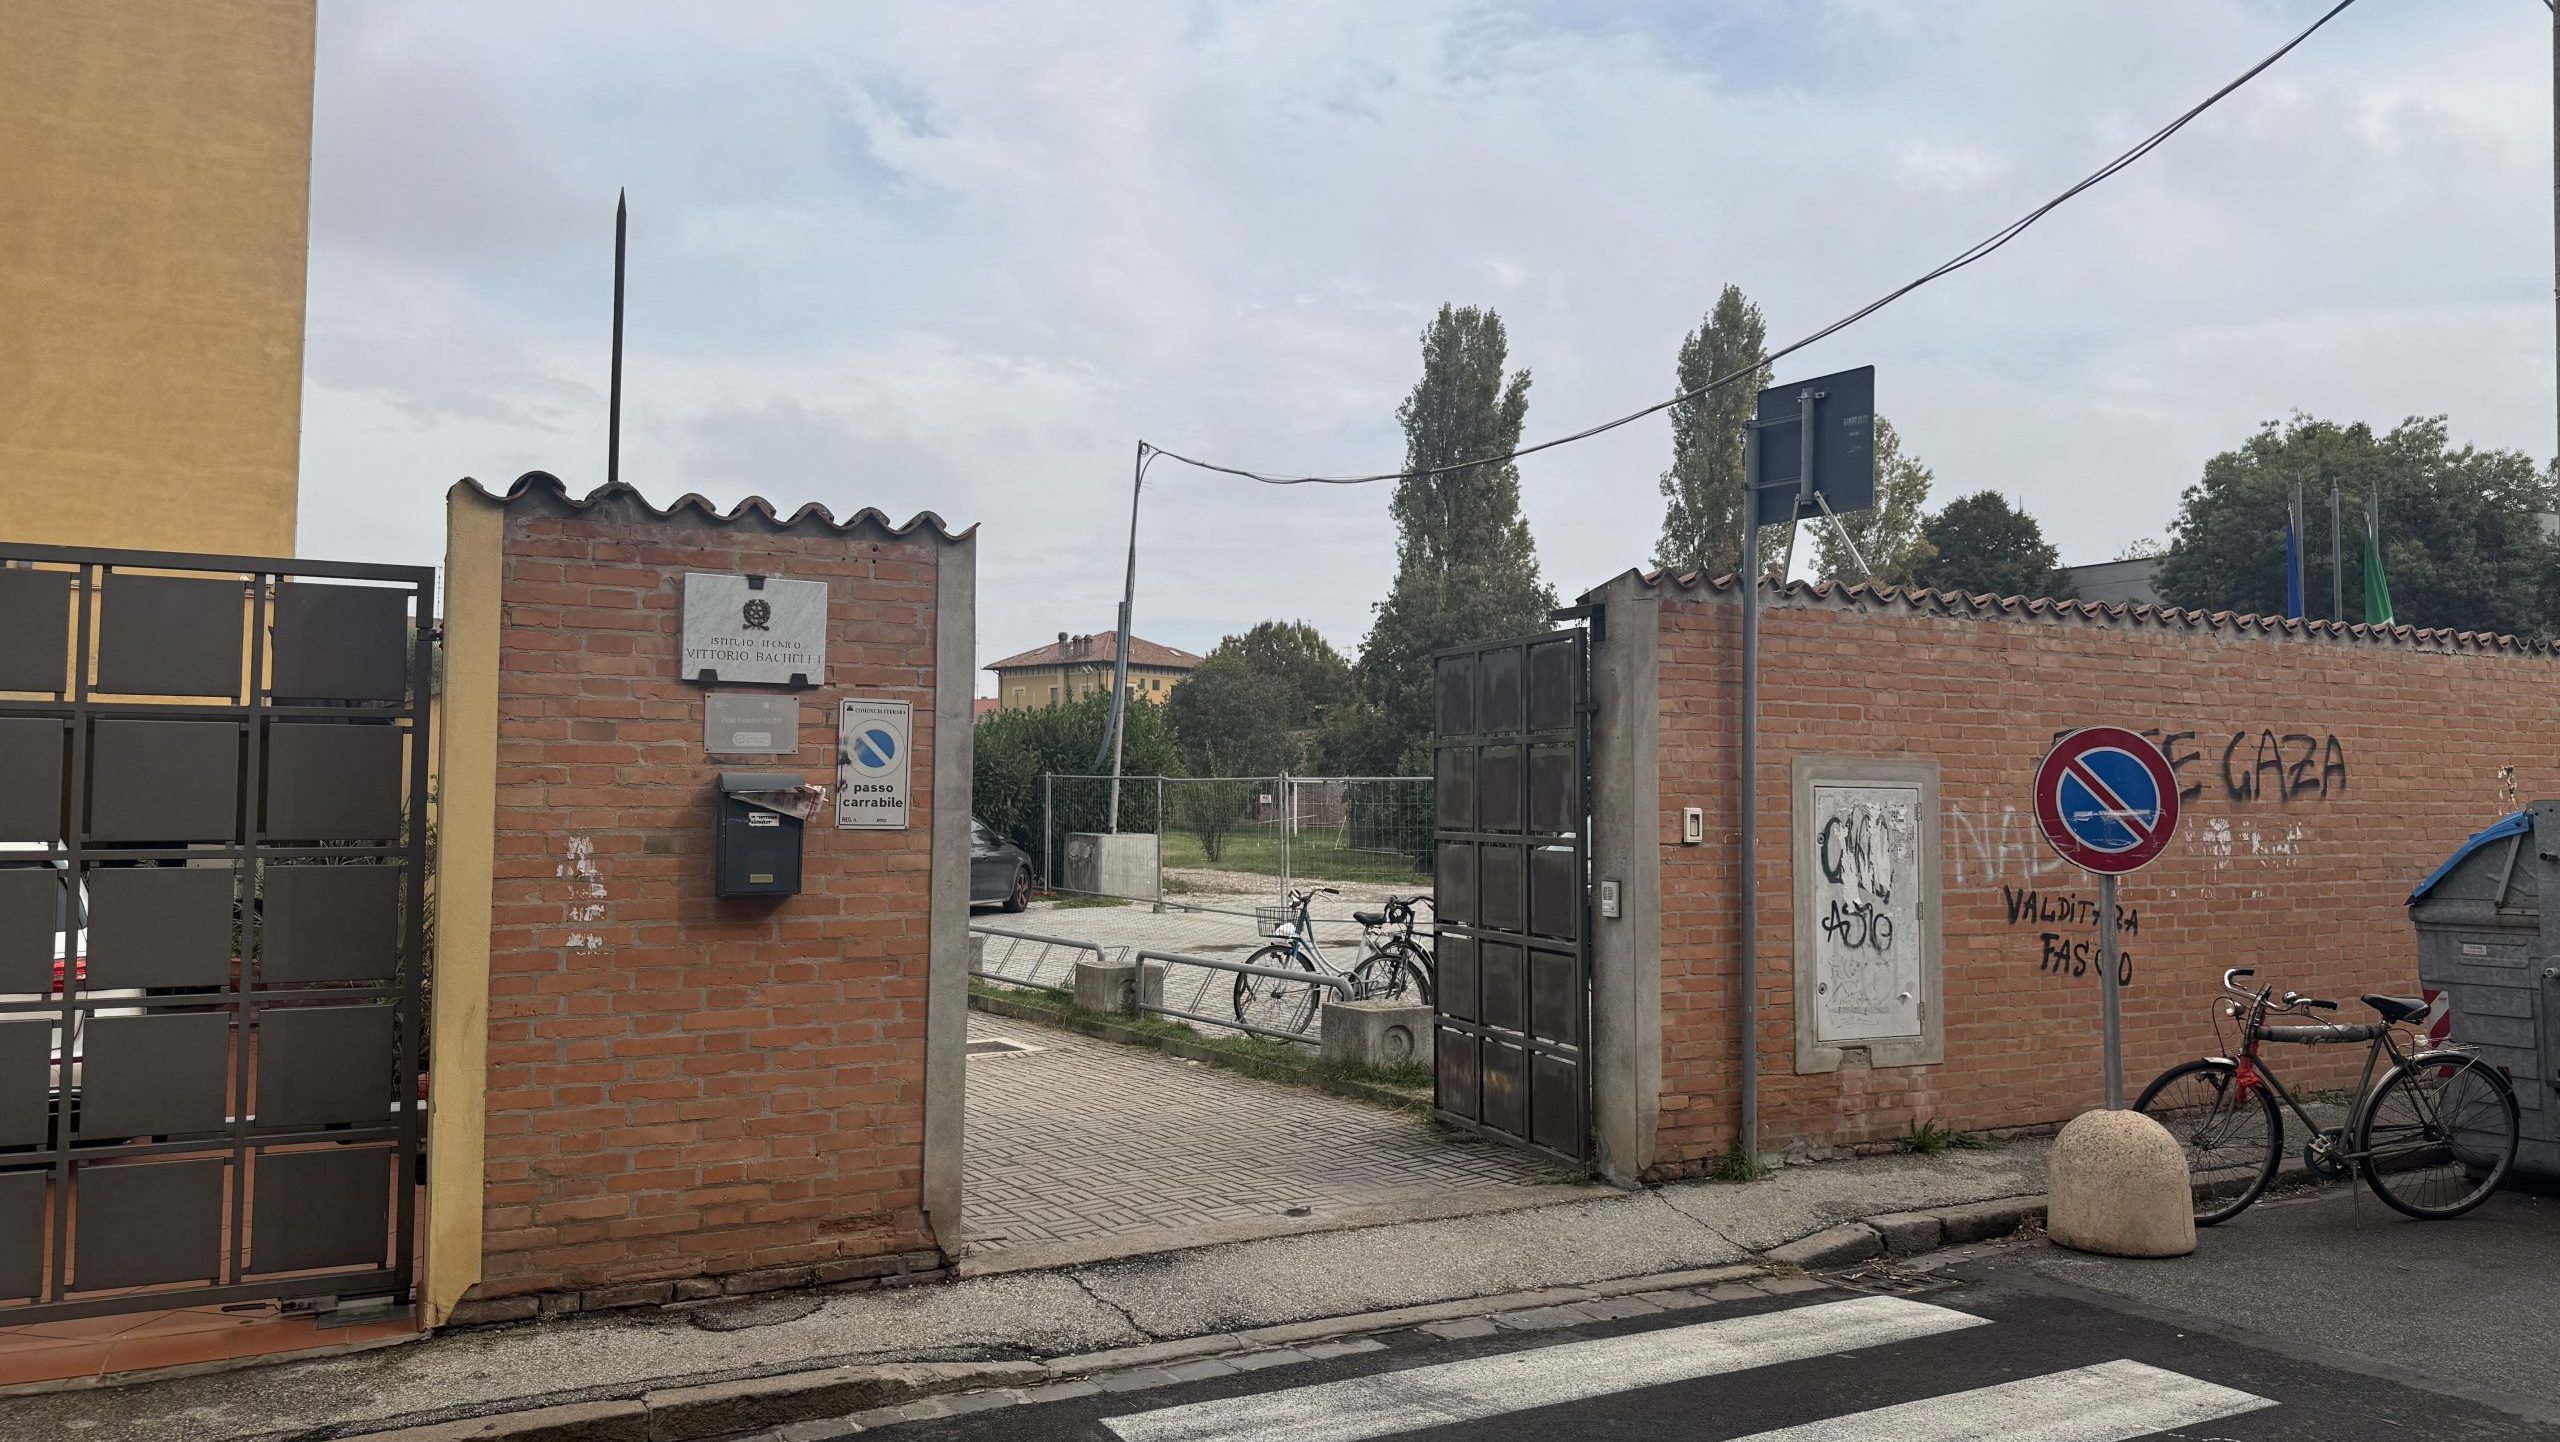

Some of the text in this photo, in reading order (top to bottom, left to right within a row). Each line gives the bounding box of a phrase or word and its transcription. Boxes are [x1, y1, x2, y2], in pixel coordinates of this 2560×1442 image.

[686, 648, 749, 661] VITTORIO
[2222, 728, 2347, 802] GAZA
[854, 784, 894, 794] passo
[843, 797, 903, 808] carrabile
